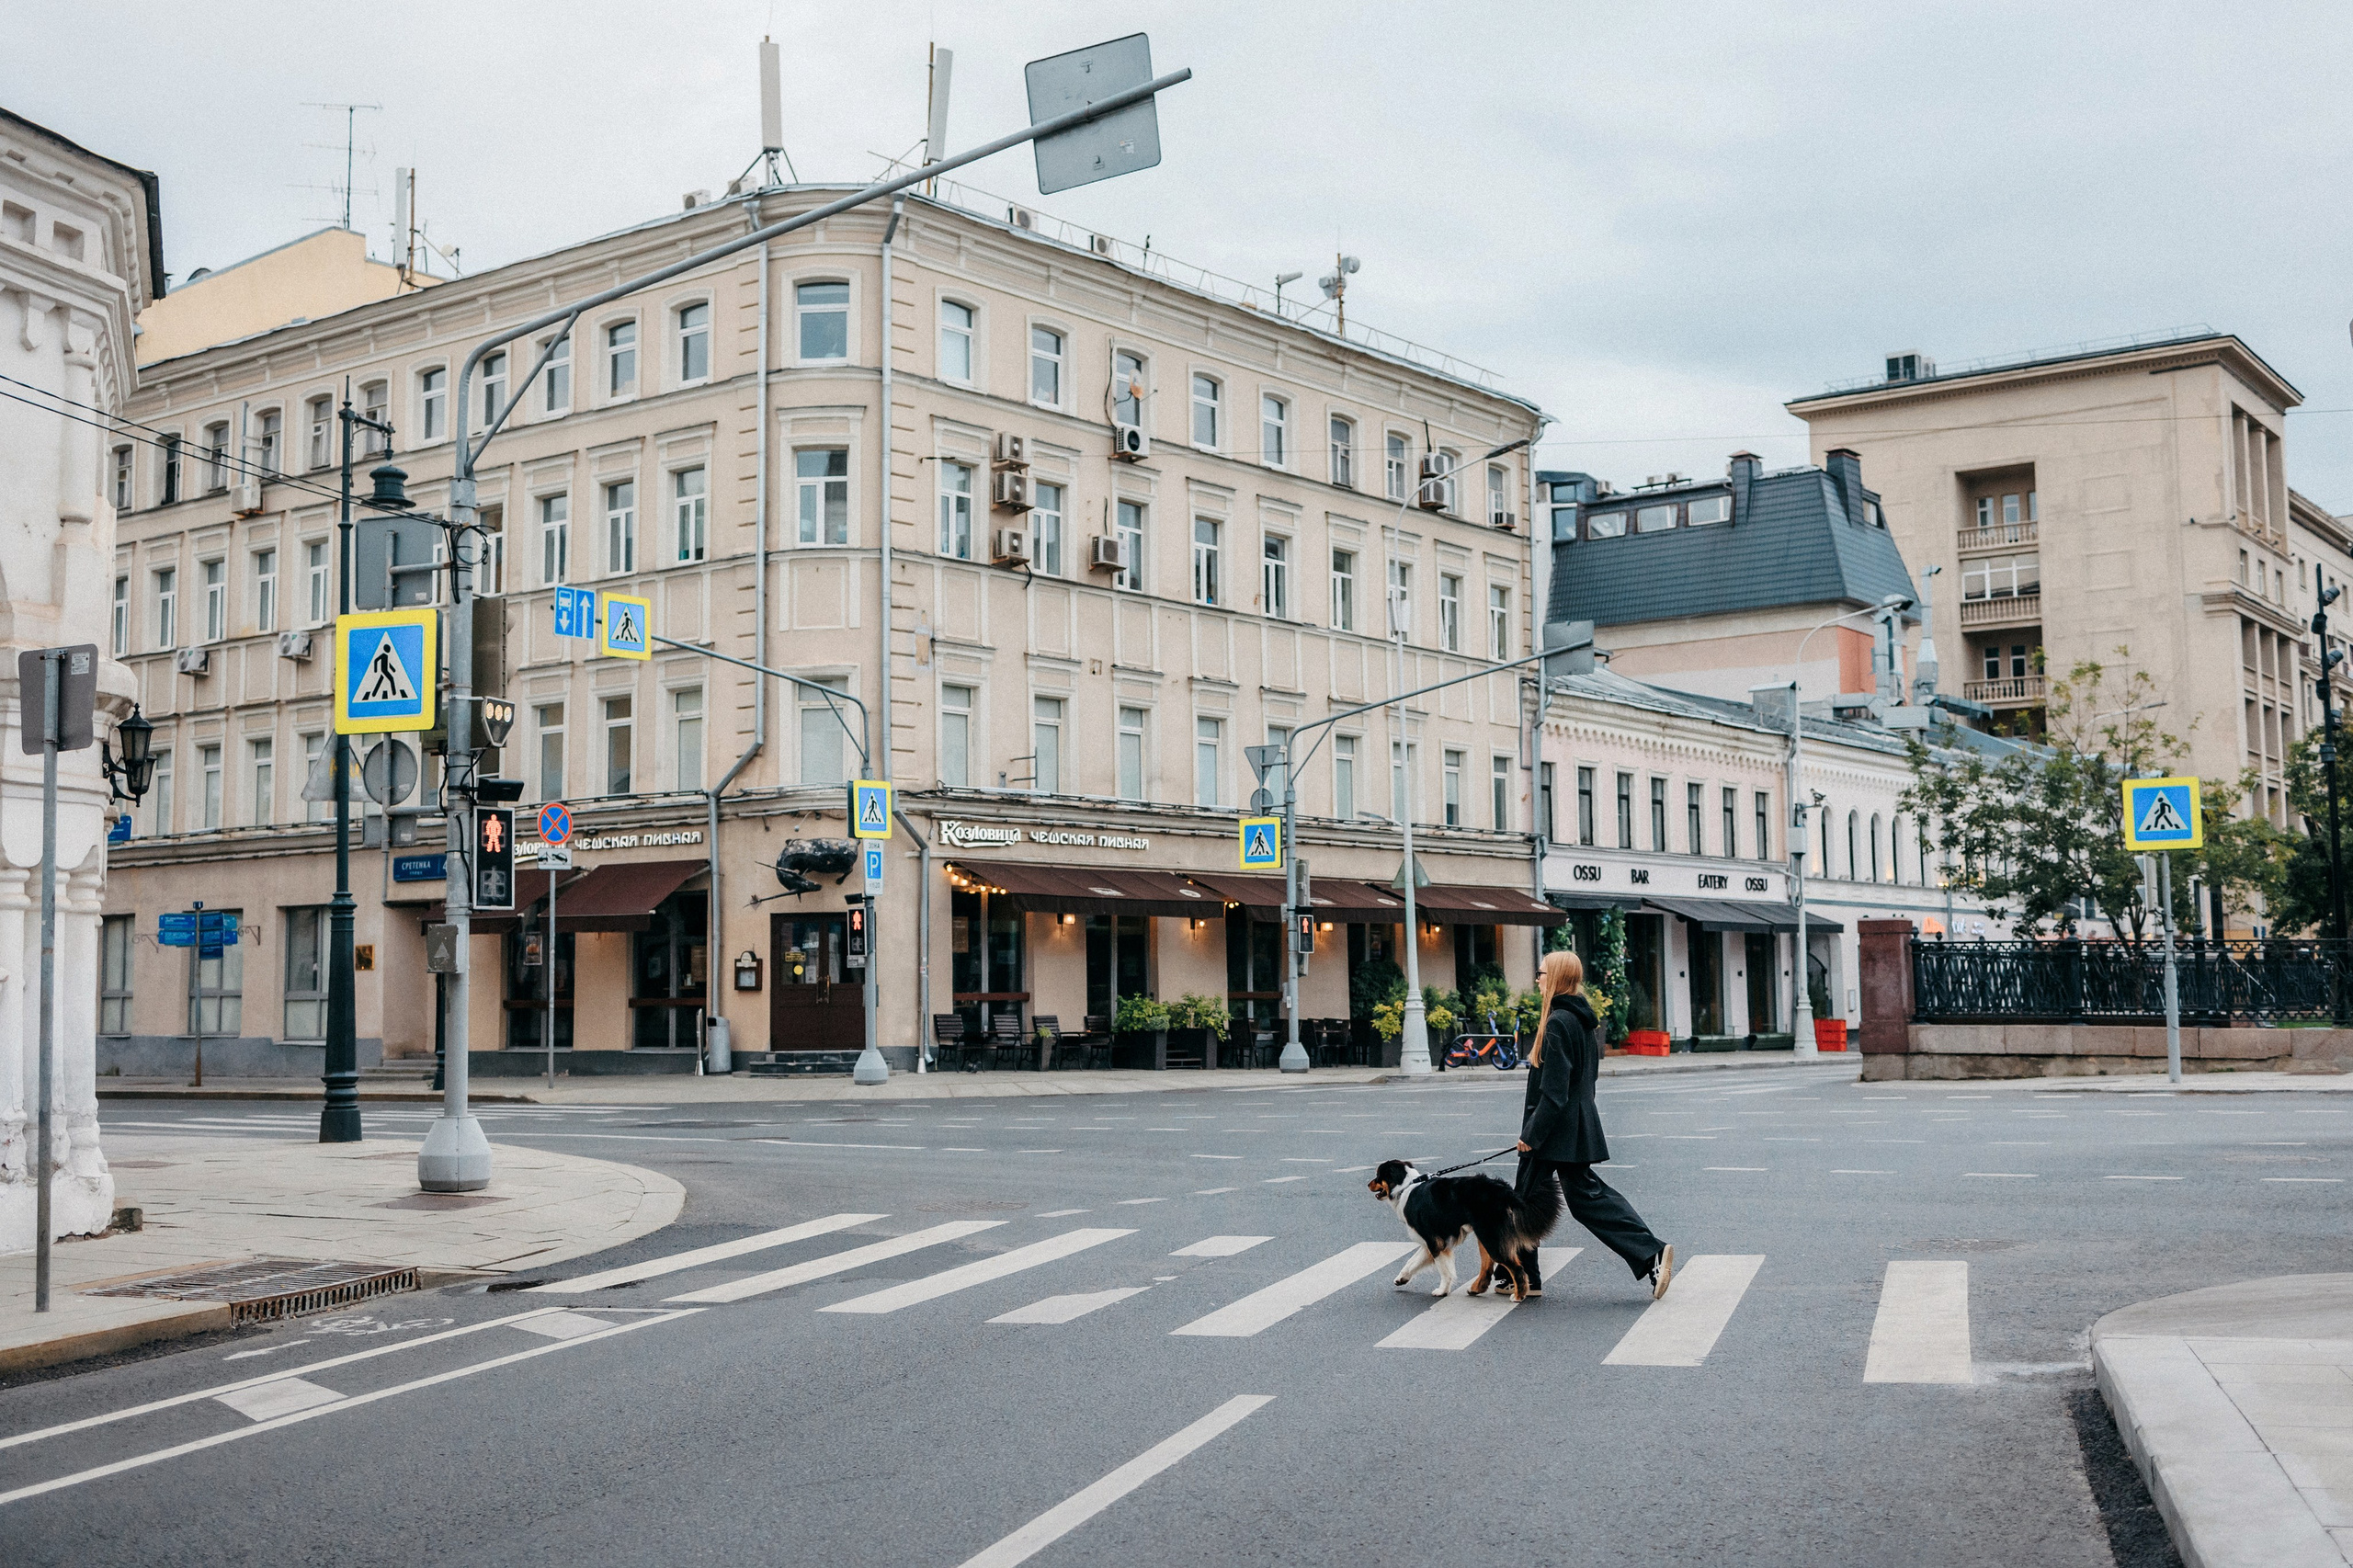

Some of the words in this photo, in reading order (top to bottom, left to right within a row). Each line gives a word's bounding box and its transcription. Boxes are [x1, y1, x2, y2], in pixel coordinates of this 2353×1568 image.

[402, 860, 431, 870] СРЕТЕНКА
[1574, 865, 1601, 881] OSSU
[1631, 869, 1650, 884] BAR
[1699, 874, 1729, 889] EATERY
[1745, 878, 1768, 892] OSSU
